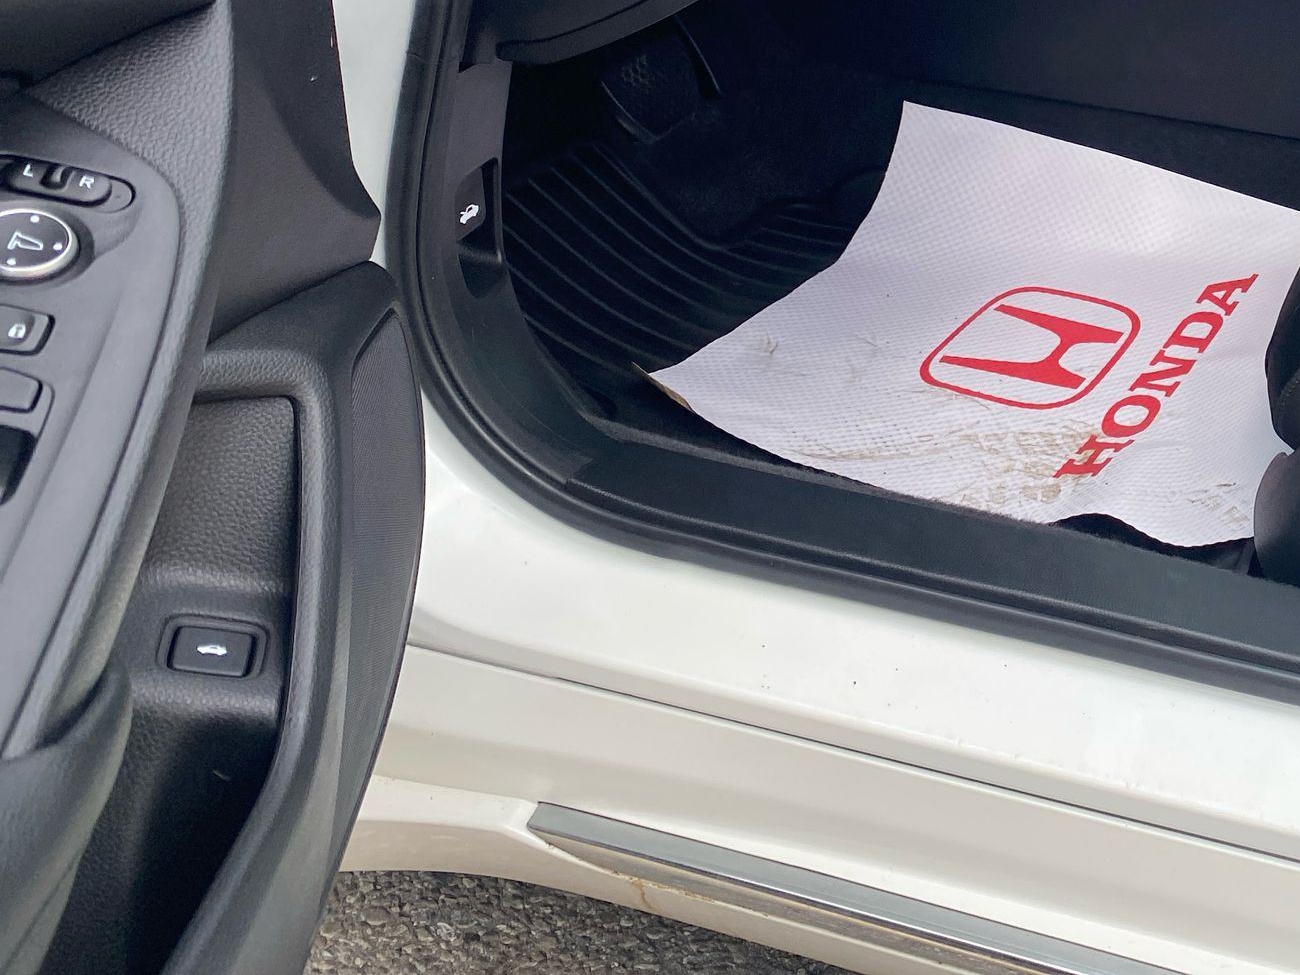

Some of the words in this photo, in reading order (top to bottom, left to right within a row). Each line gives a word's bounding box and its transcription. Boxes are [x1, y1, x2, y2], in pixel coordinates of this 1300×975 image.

[23, 164, 33, 177] L
[79, 175, 95, 189] R
[1053, 273, 1259, 478] HONDA
